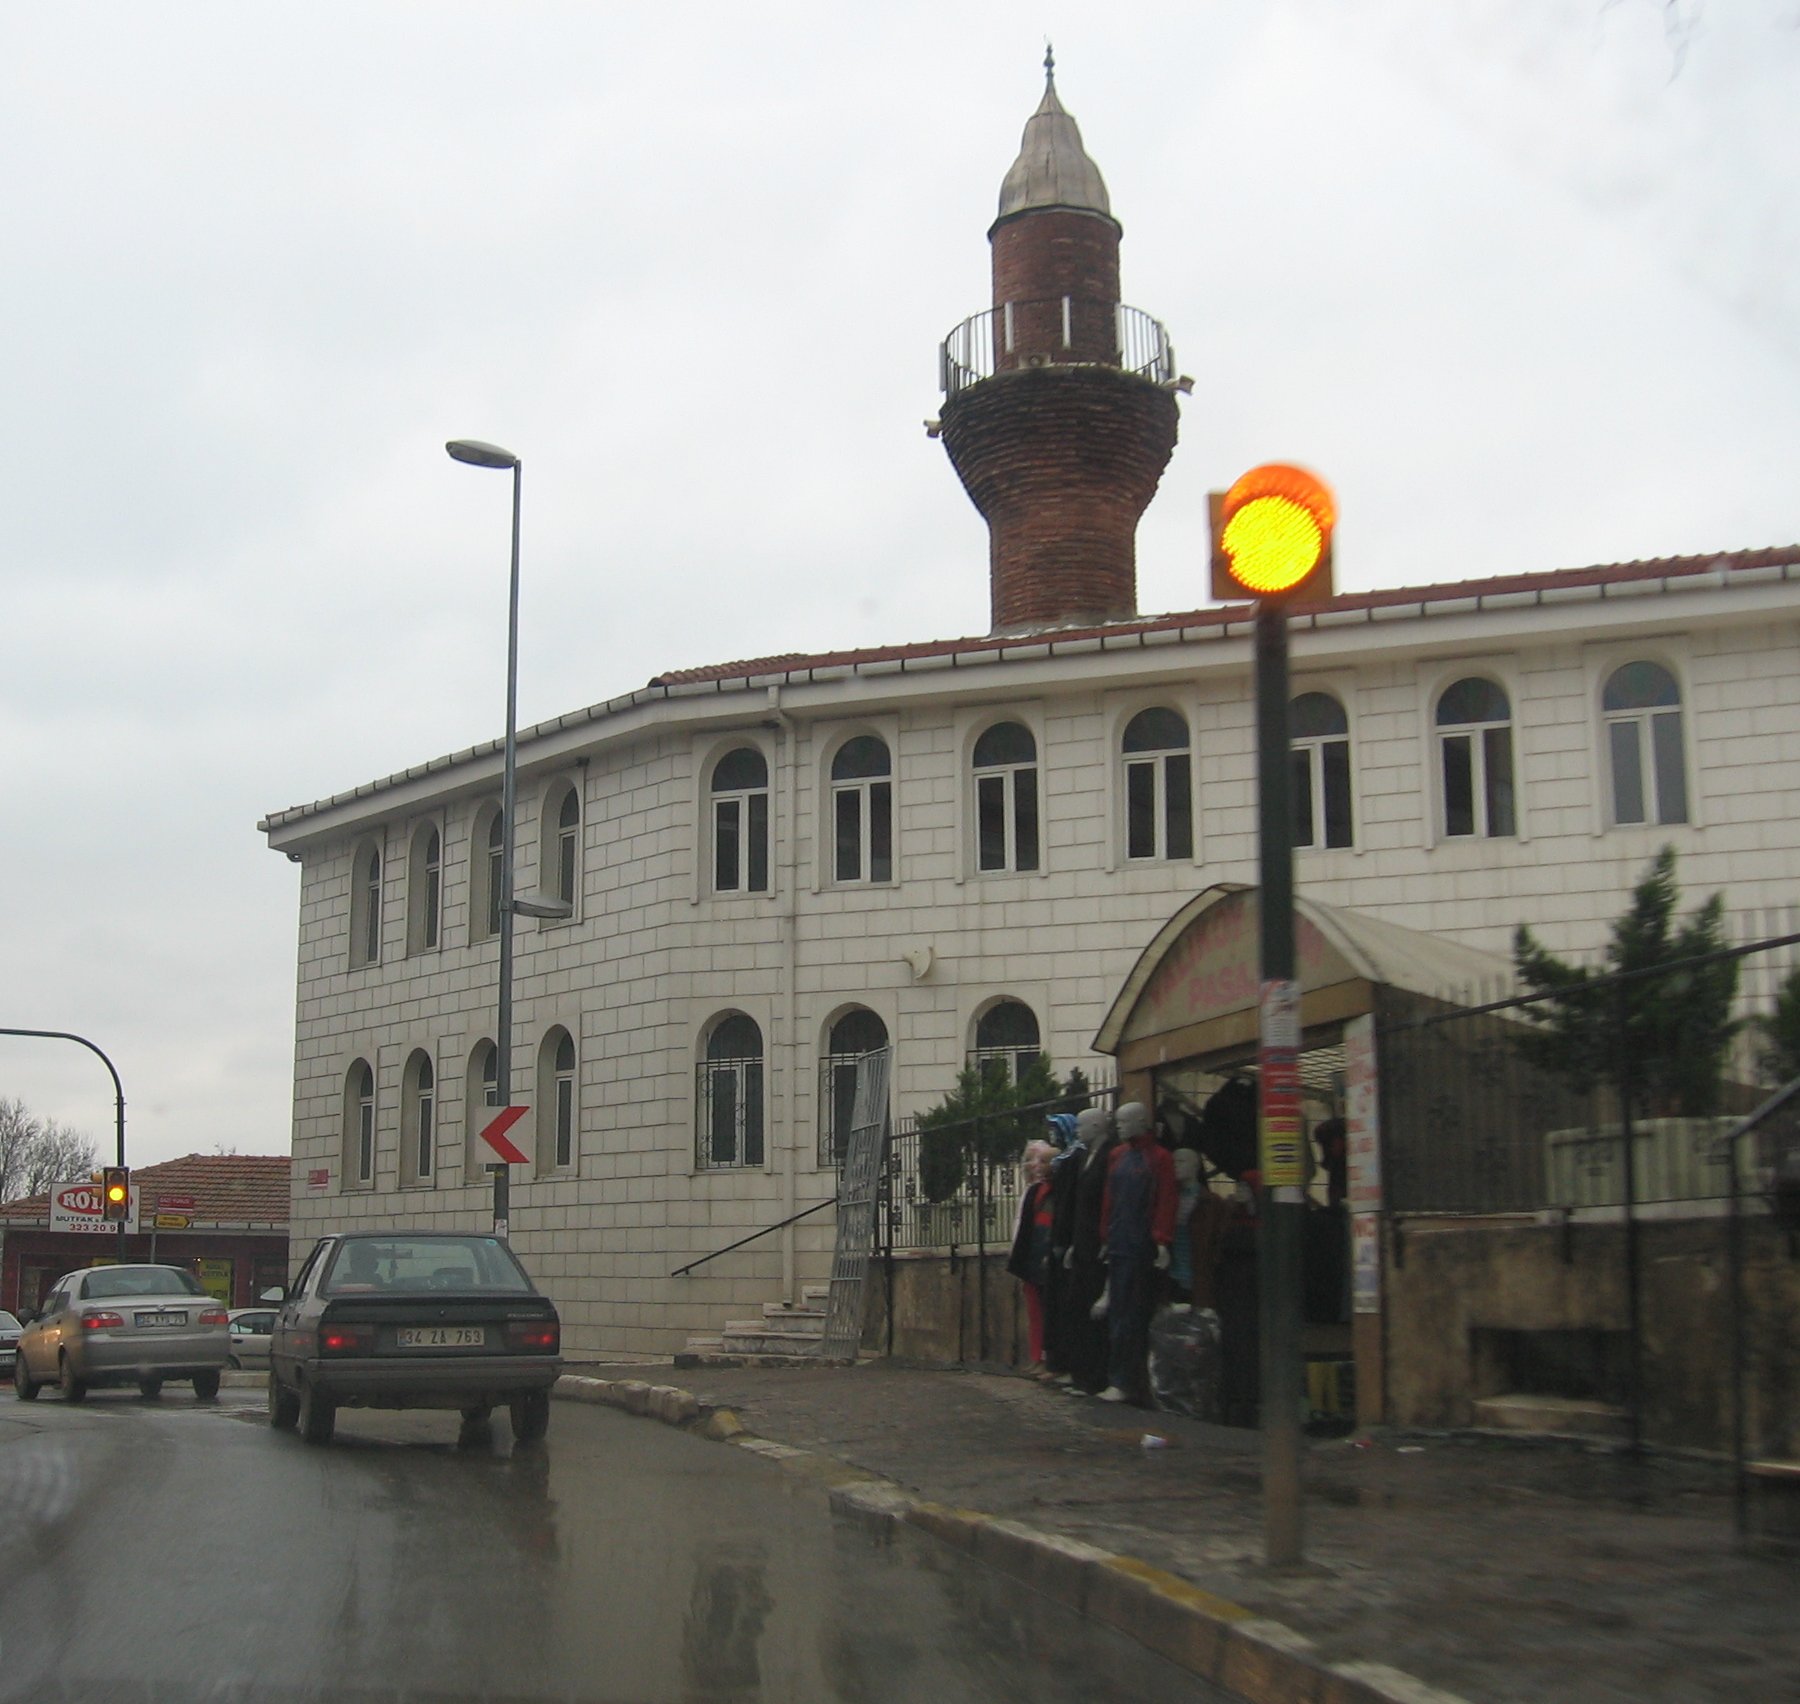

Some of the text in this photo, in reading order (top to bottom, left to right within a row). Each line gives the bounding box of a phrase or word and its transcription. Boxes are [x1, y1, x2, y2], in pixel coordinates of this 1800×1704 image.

[93, 1224, 107, 1232] 20
[405, 1329, 481, 1344] 34 ZA 763
